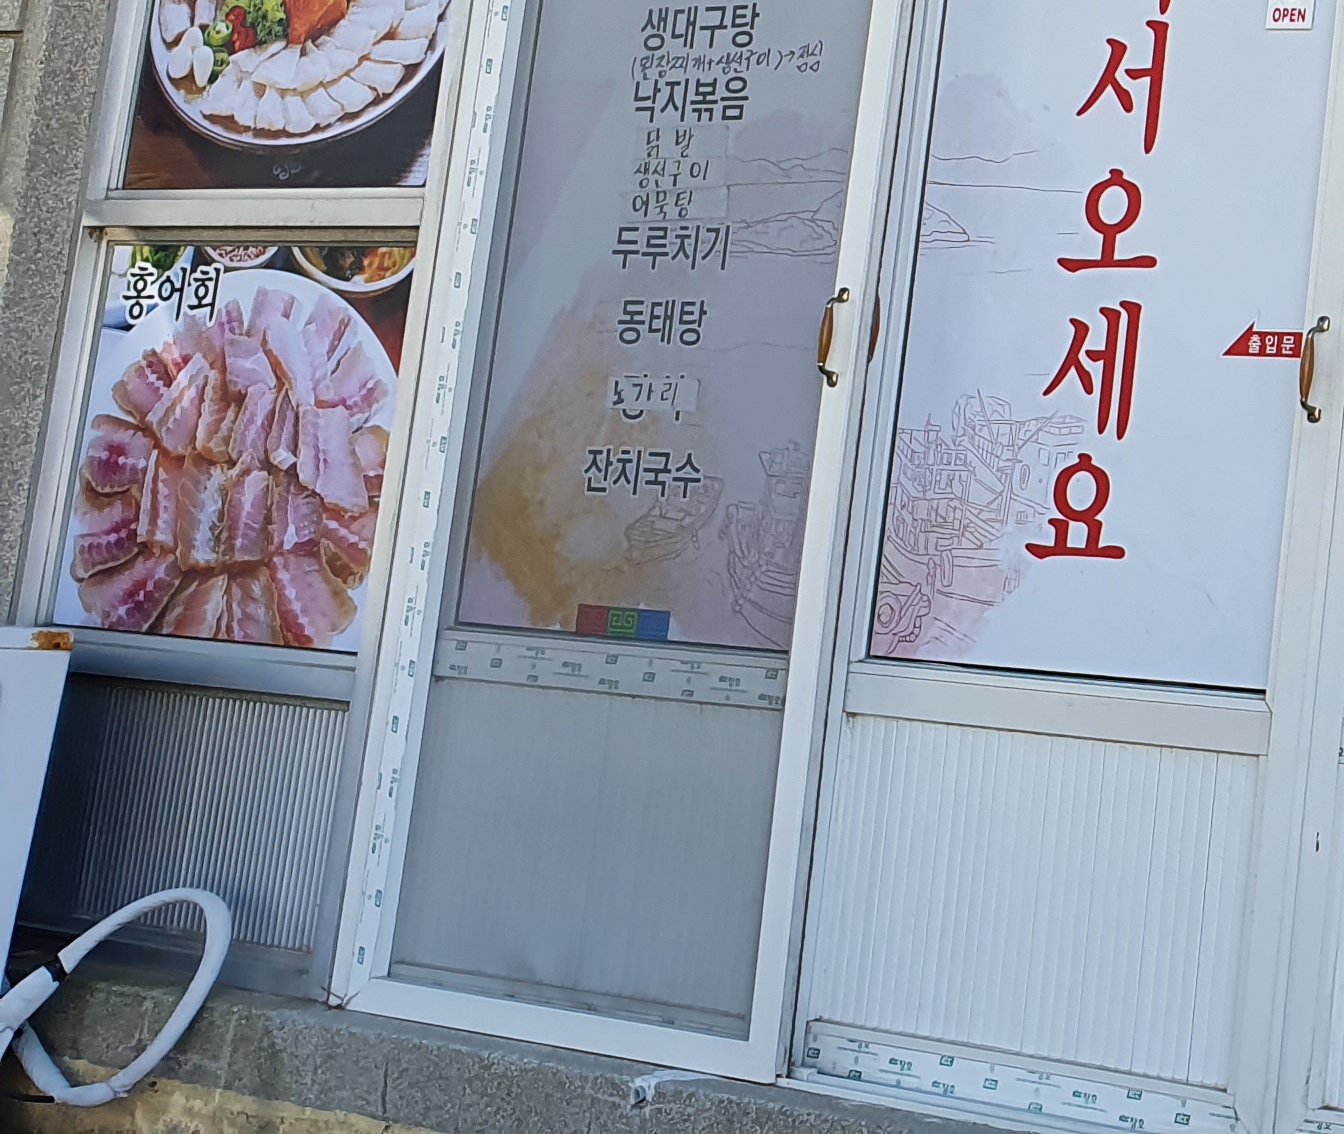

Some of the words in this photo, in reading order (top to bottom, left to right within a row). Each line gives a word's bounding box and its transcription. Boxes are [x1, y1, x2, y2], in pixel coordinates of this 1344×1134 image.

[641, 2, 760, 51] 생대구탕
[1272, 8, 1306, 23] OPEN
[633, 76, 750, 123] 낙지볶음
[612, 225, 731, 270] 두루치기
[122, 266, 221, 322] 홍어회
[617, 299, 707, 346] 동태탕
[1248, 334, 1295, 354] 출입문
[584, 447, 702, 499] 잔치국수
